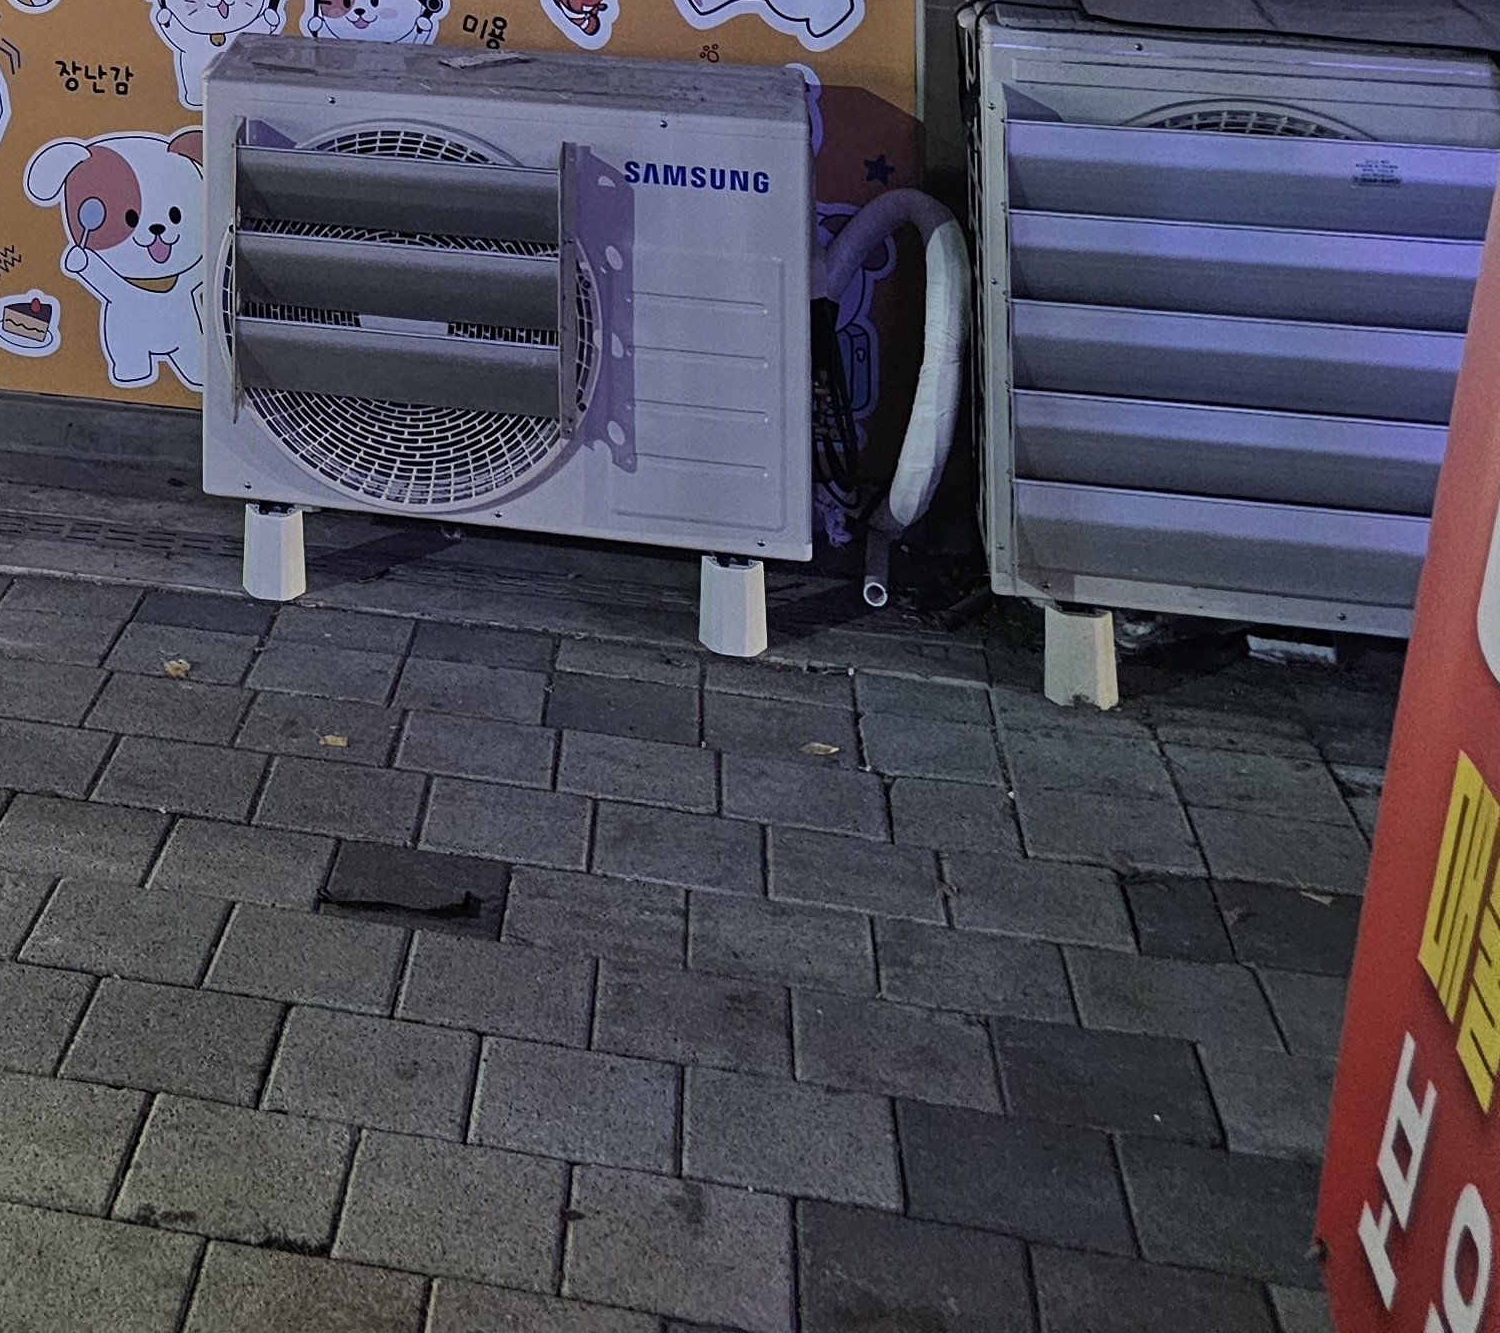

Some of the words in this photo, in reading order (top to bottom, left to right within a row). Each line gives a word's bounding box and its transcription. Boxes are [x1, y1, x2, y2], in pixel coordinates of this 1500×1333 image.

[463, 13, 508, 50] 미용
[55, 59, 135, 97] 장난감
[624, 160, 771, 195] SAMSUNG
